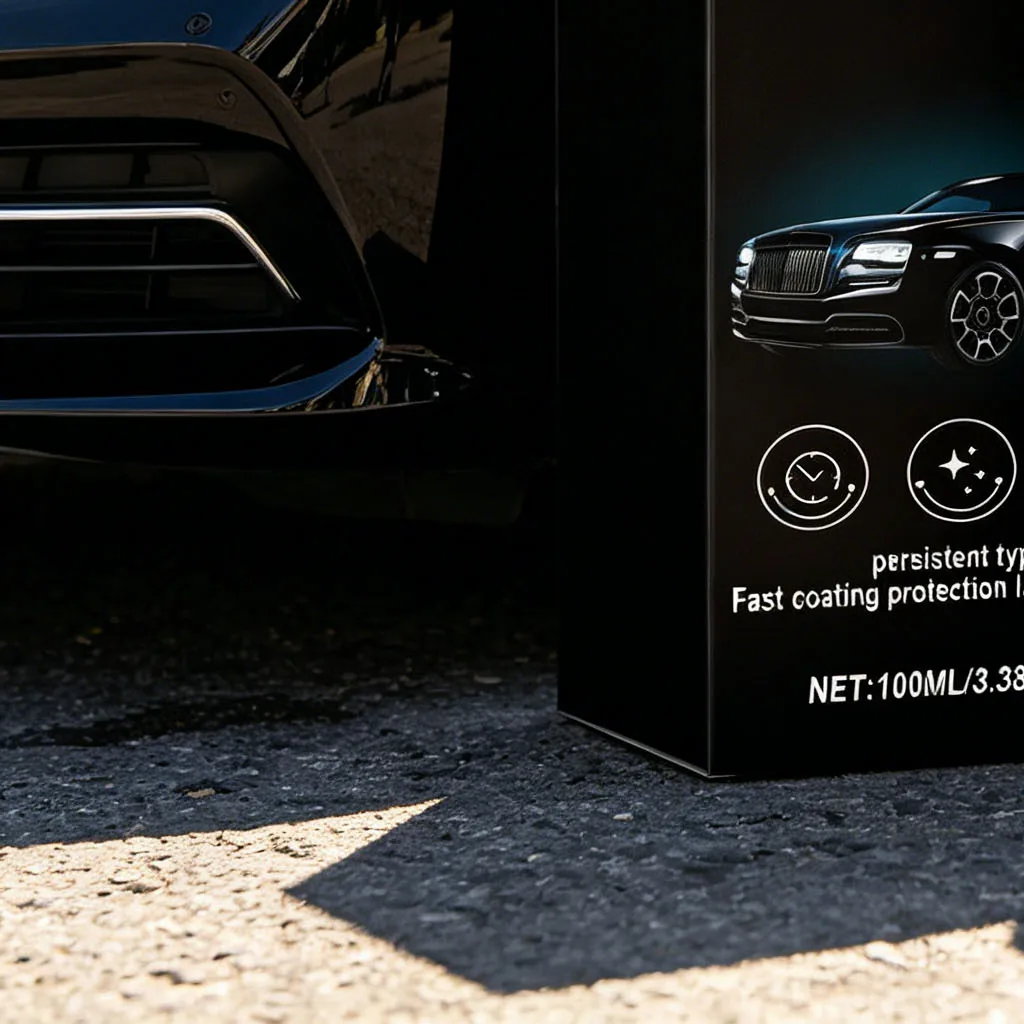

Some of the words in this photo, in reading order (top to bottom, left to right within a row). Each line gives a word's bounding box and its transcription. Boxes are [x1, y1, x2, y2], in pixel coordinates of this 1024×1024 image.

[872, 544, 990, 580] persistent
[732, 585, 784, 614] Fast
[791, 582, 879, 613] coating
[887, 576, 1007, 611] protection
